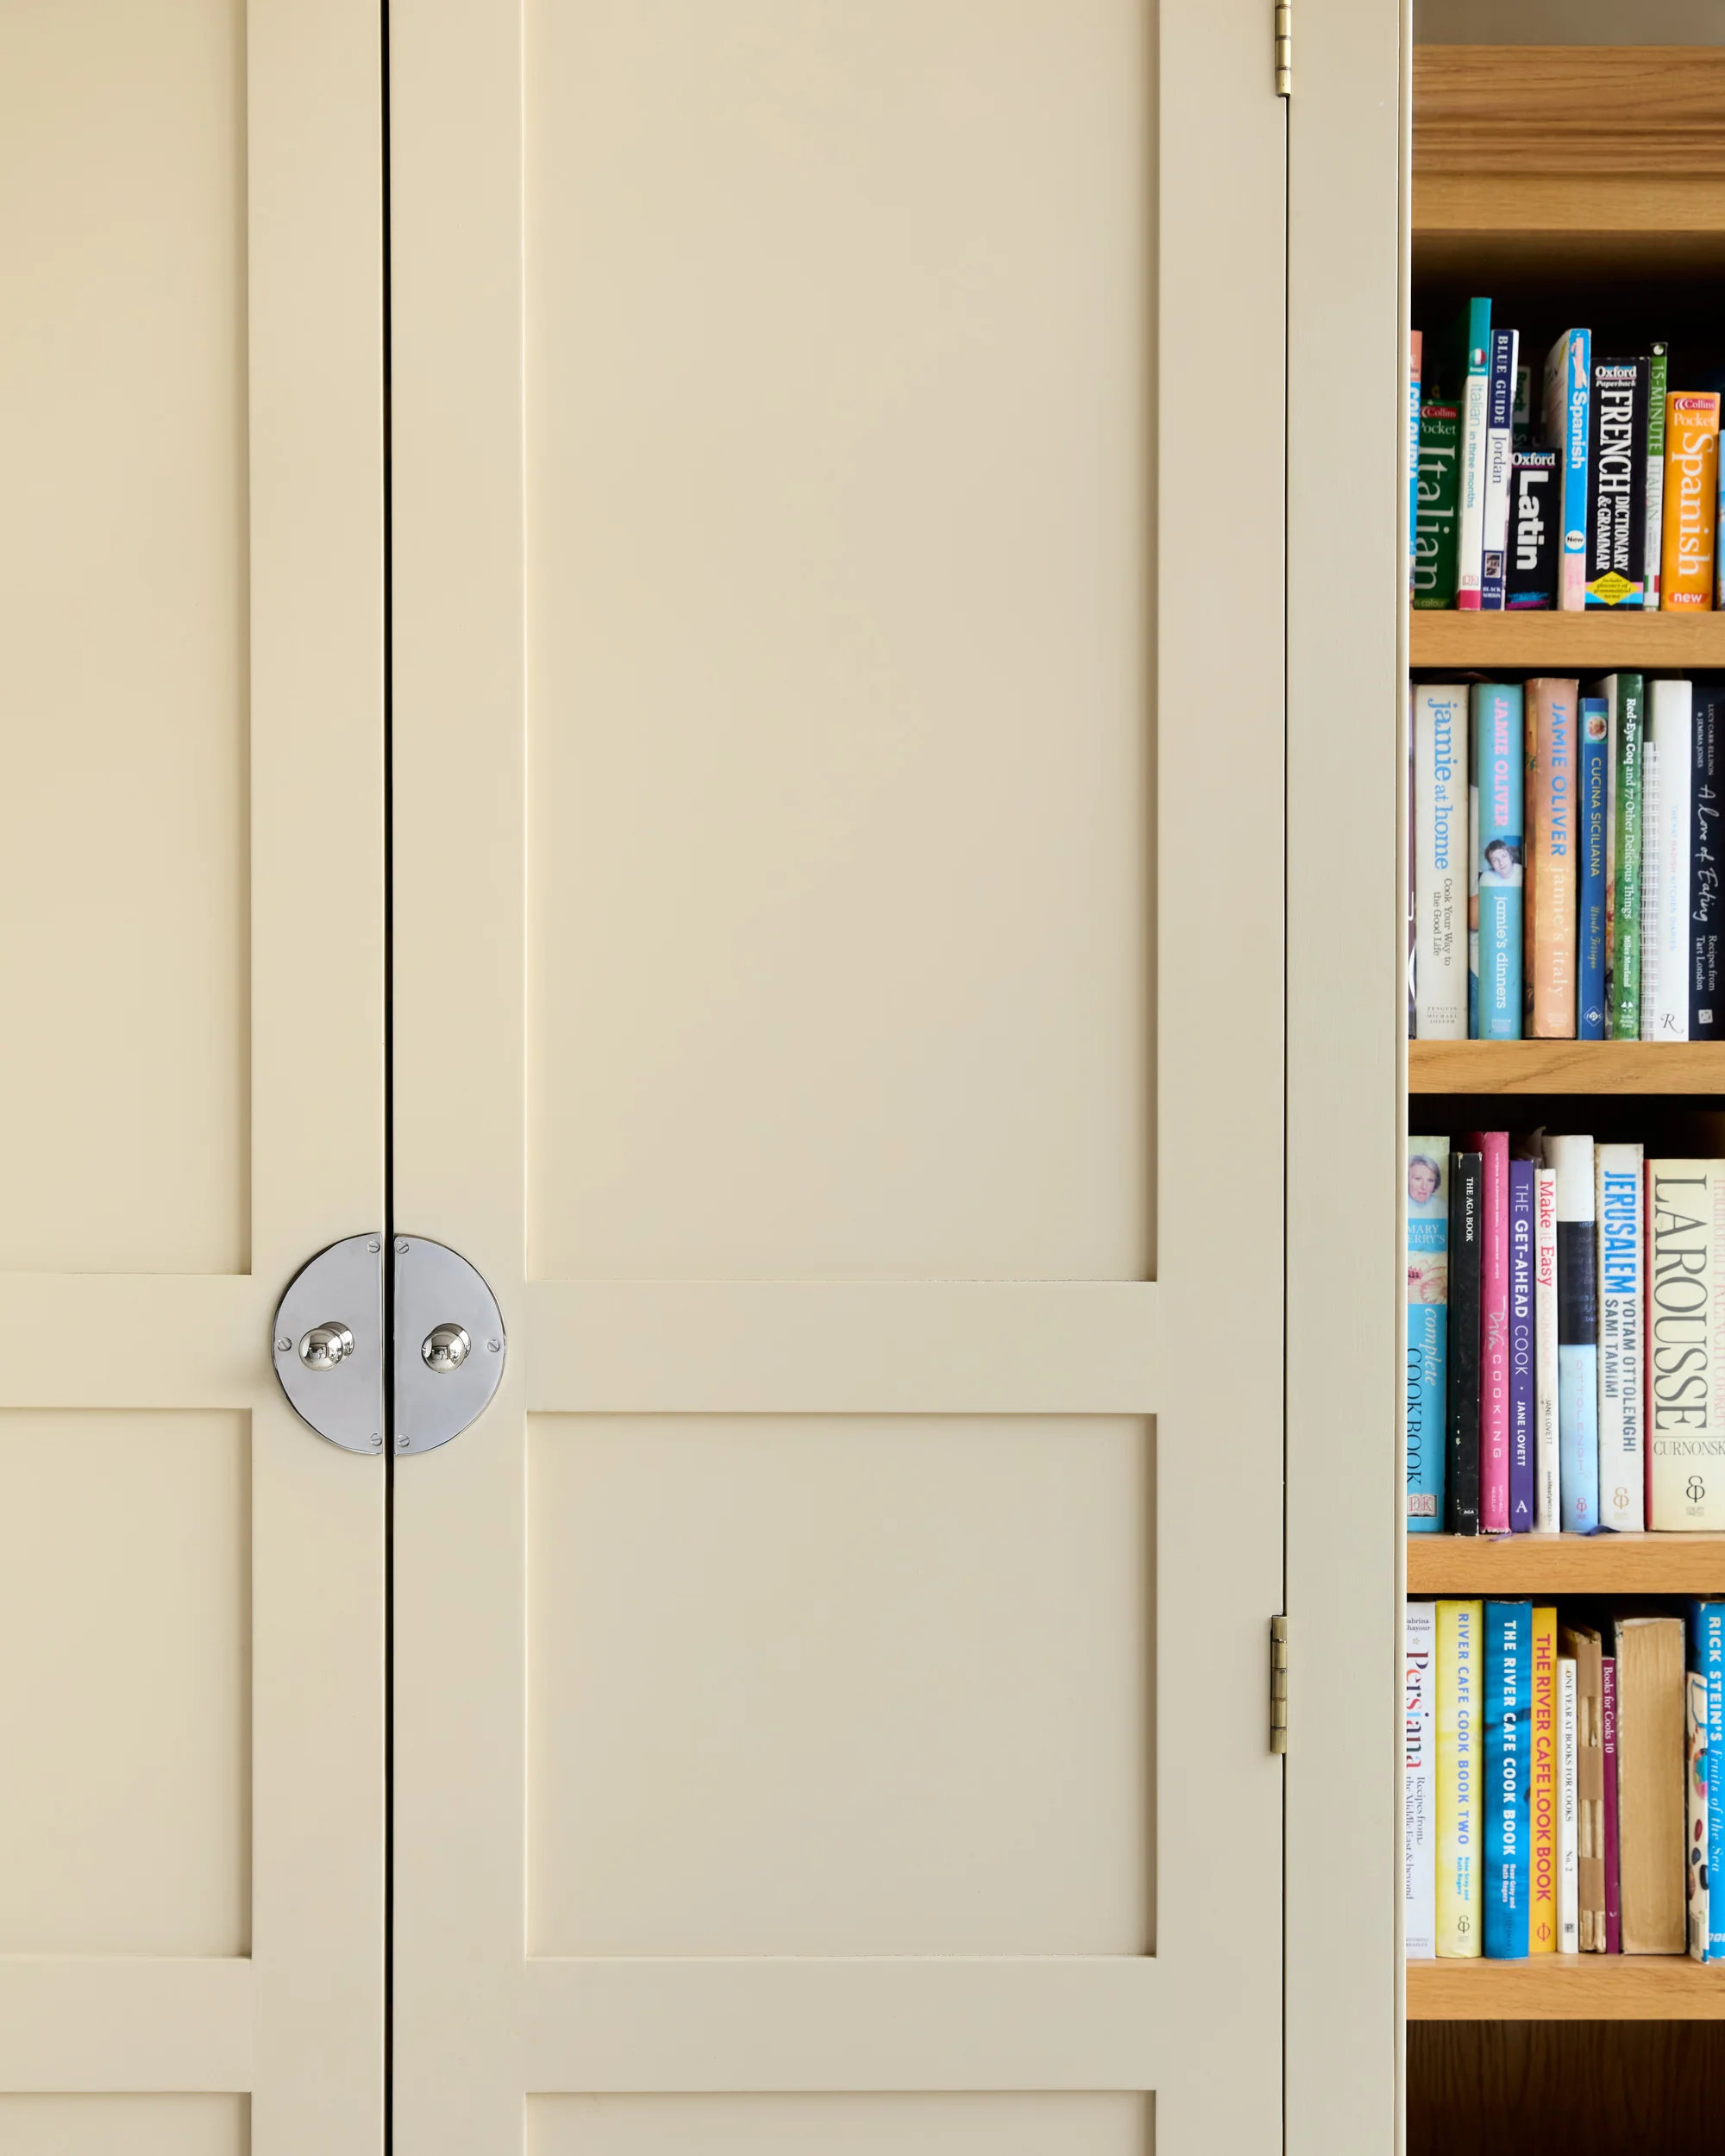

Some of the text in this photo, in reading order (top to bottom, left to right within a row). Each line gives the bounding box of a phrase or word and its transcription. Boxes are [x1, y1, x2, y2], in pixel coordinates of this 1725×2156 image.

[1495, 335, 1509, 423] BLUE GUIDE
[1596, 366, 1637, 379] Oxford
[1684, 399, 1715, 410] Collins
[1427, 407, 1457, 417] Collins
[1570, 391, 1588, 468] Spanish
[1649, 365, 1665, 450] 15-MINUTE
[1673, 412, 1715, 427] Pocket
[1466, 384, 1484, 508] Italian in three months
[1492, 436, 1507, 484] Jordan
[1512, 452, 1555, 466] Oxford
[1599, 390, 1634, 494] FRENCH
[1414, 445, 1455, 590] Italian
[1516, 470, 1549, 570] Latin
[1614, 495, 1630, 571] DICTIONARY
[1672, 432, 1715, 577] Spanish
[1673, 592, 1703, 603] new
[1494, 697, 1509, 827] JAMIE OLIVER
[1696, 718, 1704, 768] JEMIMA JONES
[1427, 698, 1458, 870] jamie at home
[1551, 702, 1567, 856] JAMIE OLIVER
[1621, 698, 1637, 919] Red-Eye Coq and 77 Other Delicious Things
[1590, 756, 1602, 877] CUCINA SICILIANA
[1692, 784, 1719, 922] A of Eating
[1433, 909, 1442, 935] Good
[1442, 878, 1453, 966] Cook Your Way to
[1493, 896, 1509, 948] jamie's
[1549, 863, 1570, 940] jamie's
[1547, 951, 1570, 998] italy
[1623, 935, 1632, 987] Miles Morland
[1696, 935, 1706, 954] Tart
[1706, 935, 1718, 992] Recipes from
[1496, 952, 1509, 1008] dinners
[1408, 1225, 1440, 1234] MARY
[1465, 1176, 1474, 1242] THE AGA BOOK
[1537, 1180, 1555, 1288] Make Easy
[1489, 1294, 1507, 1351] Diva
[1515, 1183, 1528, 1467] THE GET-AHEAD COOK JANE LOVETT
[1603, 1171, 1637, 1452] JERUSALEM YOTAM OTTOLENGHI
[1653, 1174, 1709, 1430] LAROUSSE
[1418, 1307, 1442, 1386] complete
[1604, 1299, 1619, 1399] SAMI TAMIMI
[1653, 1440, 1725, 1457] CURNONSK
[1409, 1496, 1433, 1512] DK
[1515, 1500, 1528, 1514] A
[1709, 1616, 1722, 1663] RICK
[1406, 1650, 1430, 1769] Persiana
[1458, 1614, 1470, 1846] RIVER CAFE COOK BOOK TWO
[1502, 1620, 1517, 1856] THE RIVER CAFE COOK BOOK
[1565, 1720, 1573, 1732] AT
[1603, 1666, 1615, 1753] Books for Cooks 10
[1536, 1633, 1552, 1902] THE RIVER CAFE LOOK BOOK
[1565, 1733, 1573, 1765] BOOKS
[1406, 1795, 1414, 1827] Middle
[1414, 1777, 1427, 1845] Recipes from
[1708, 1796, 1723, 1812] of
[1710, 1813, 1723, 1840] the
[1406, 1852, 1414, 1862] &
[1406, 1865, 1414, 1900] beyond
[1710, 1846, 1723, 1872] Sea
